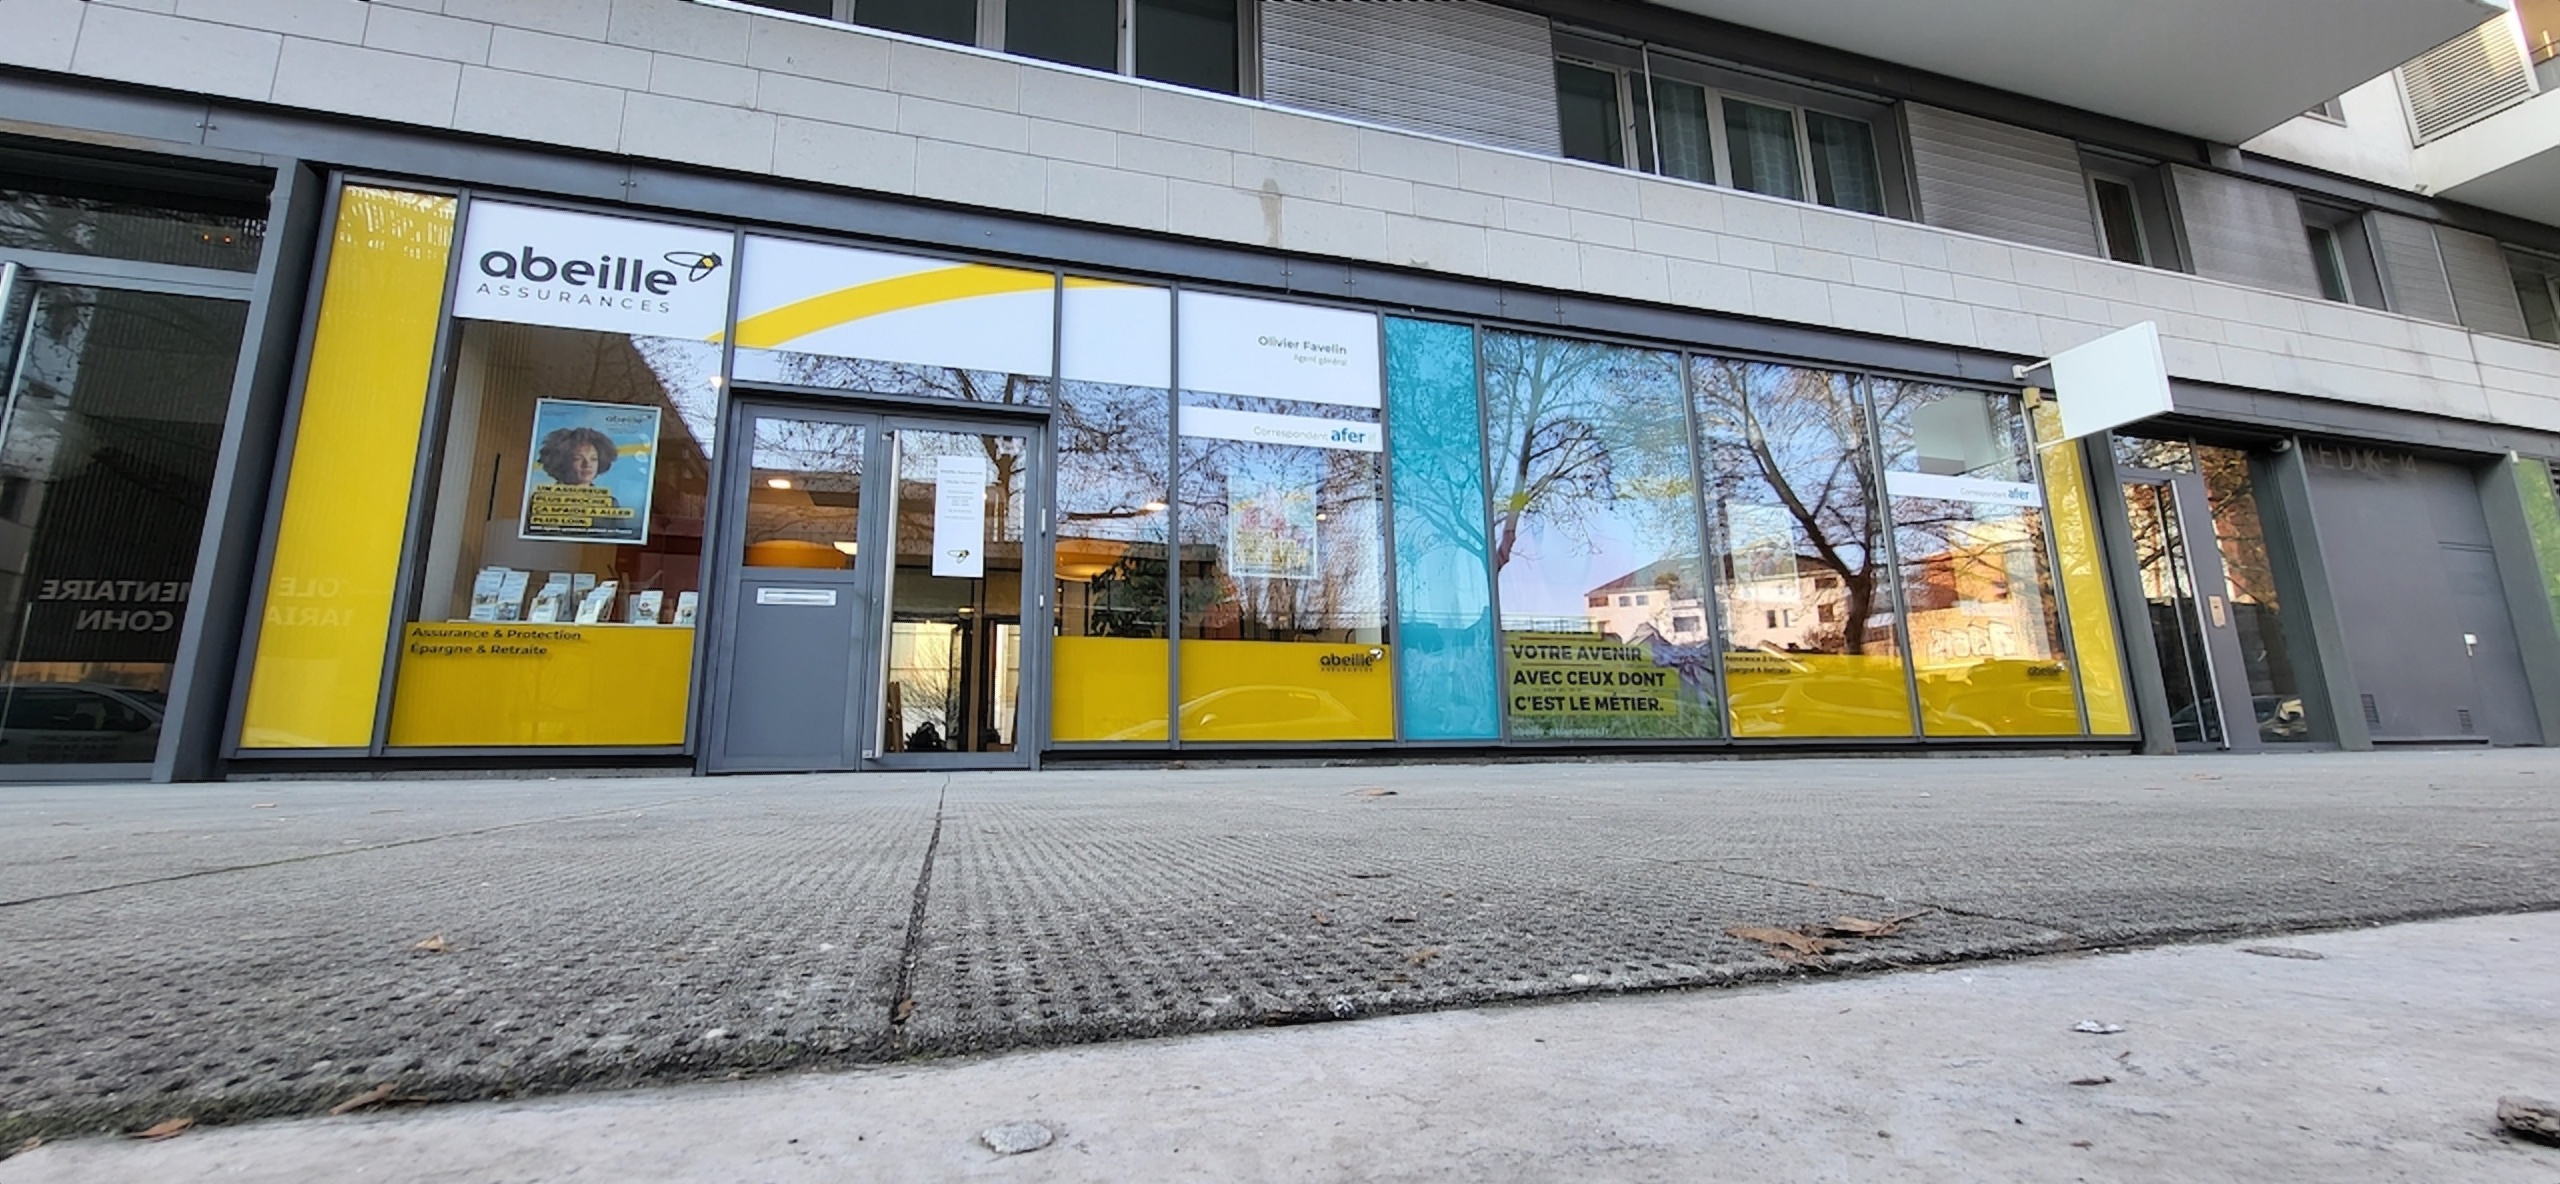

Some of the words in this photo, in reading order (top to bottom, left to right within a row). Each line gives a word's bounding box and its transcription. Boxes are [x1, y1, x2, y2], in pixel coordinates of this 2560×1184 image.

[479, 246, 677, 296] abeille
[476, 282, 670, 314] ASSURANCES
[1258, 336, 1299, 350] Olivier
[1303, 341, 1347, 354] Favelin
[1331, 428, 1366, 443] afer
[2008, 488, 2029, 500] afer
[411, 627, 490, 640] Assurance
[493, 629, 503, 639] &
[507, 630, 582, 641] Protection
[410, 642, 473, 655] Épargne
[475, 644, 486, 654] &
[490, 644, 548, 655] Retraite
[1511, 644, 1573, 660] VOTRE
[1576, 645, 1642, 662] AVENIR
[1320, 653, 1373, 667] abeille
[1513, 670, 1563, 685] AVEC
[1566, 671, 1614, 686] CEUX
[1618, 672, 1666, 687] DONT
[1515, 695, 1566, 711] C'EST
[1570, 696, 1591, 711] LE
[1595, 691, 1664, 712] MÉTIER.
